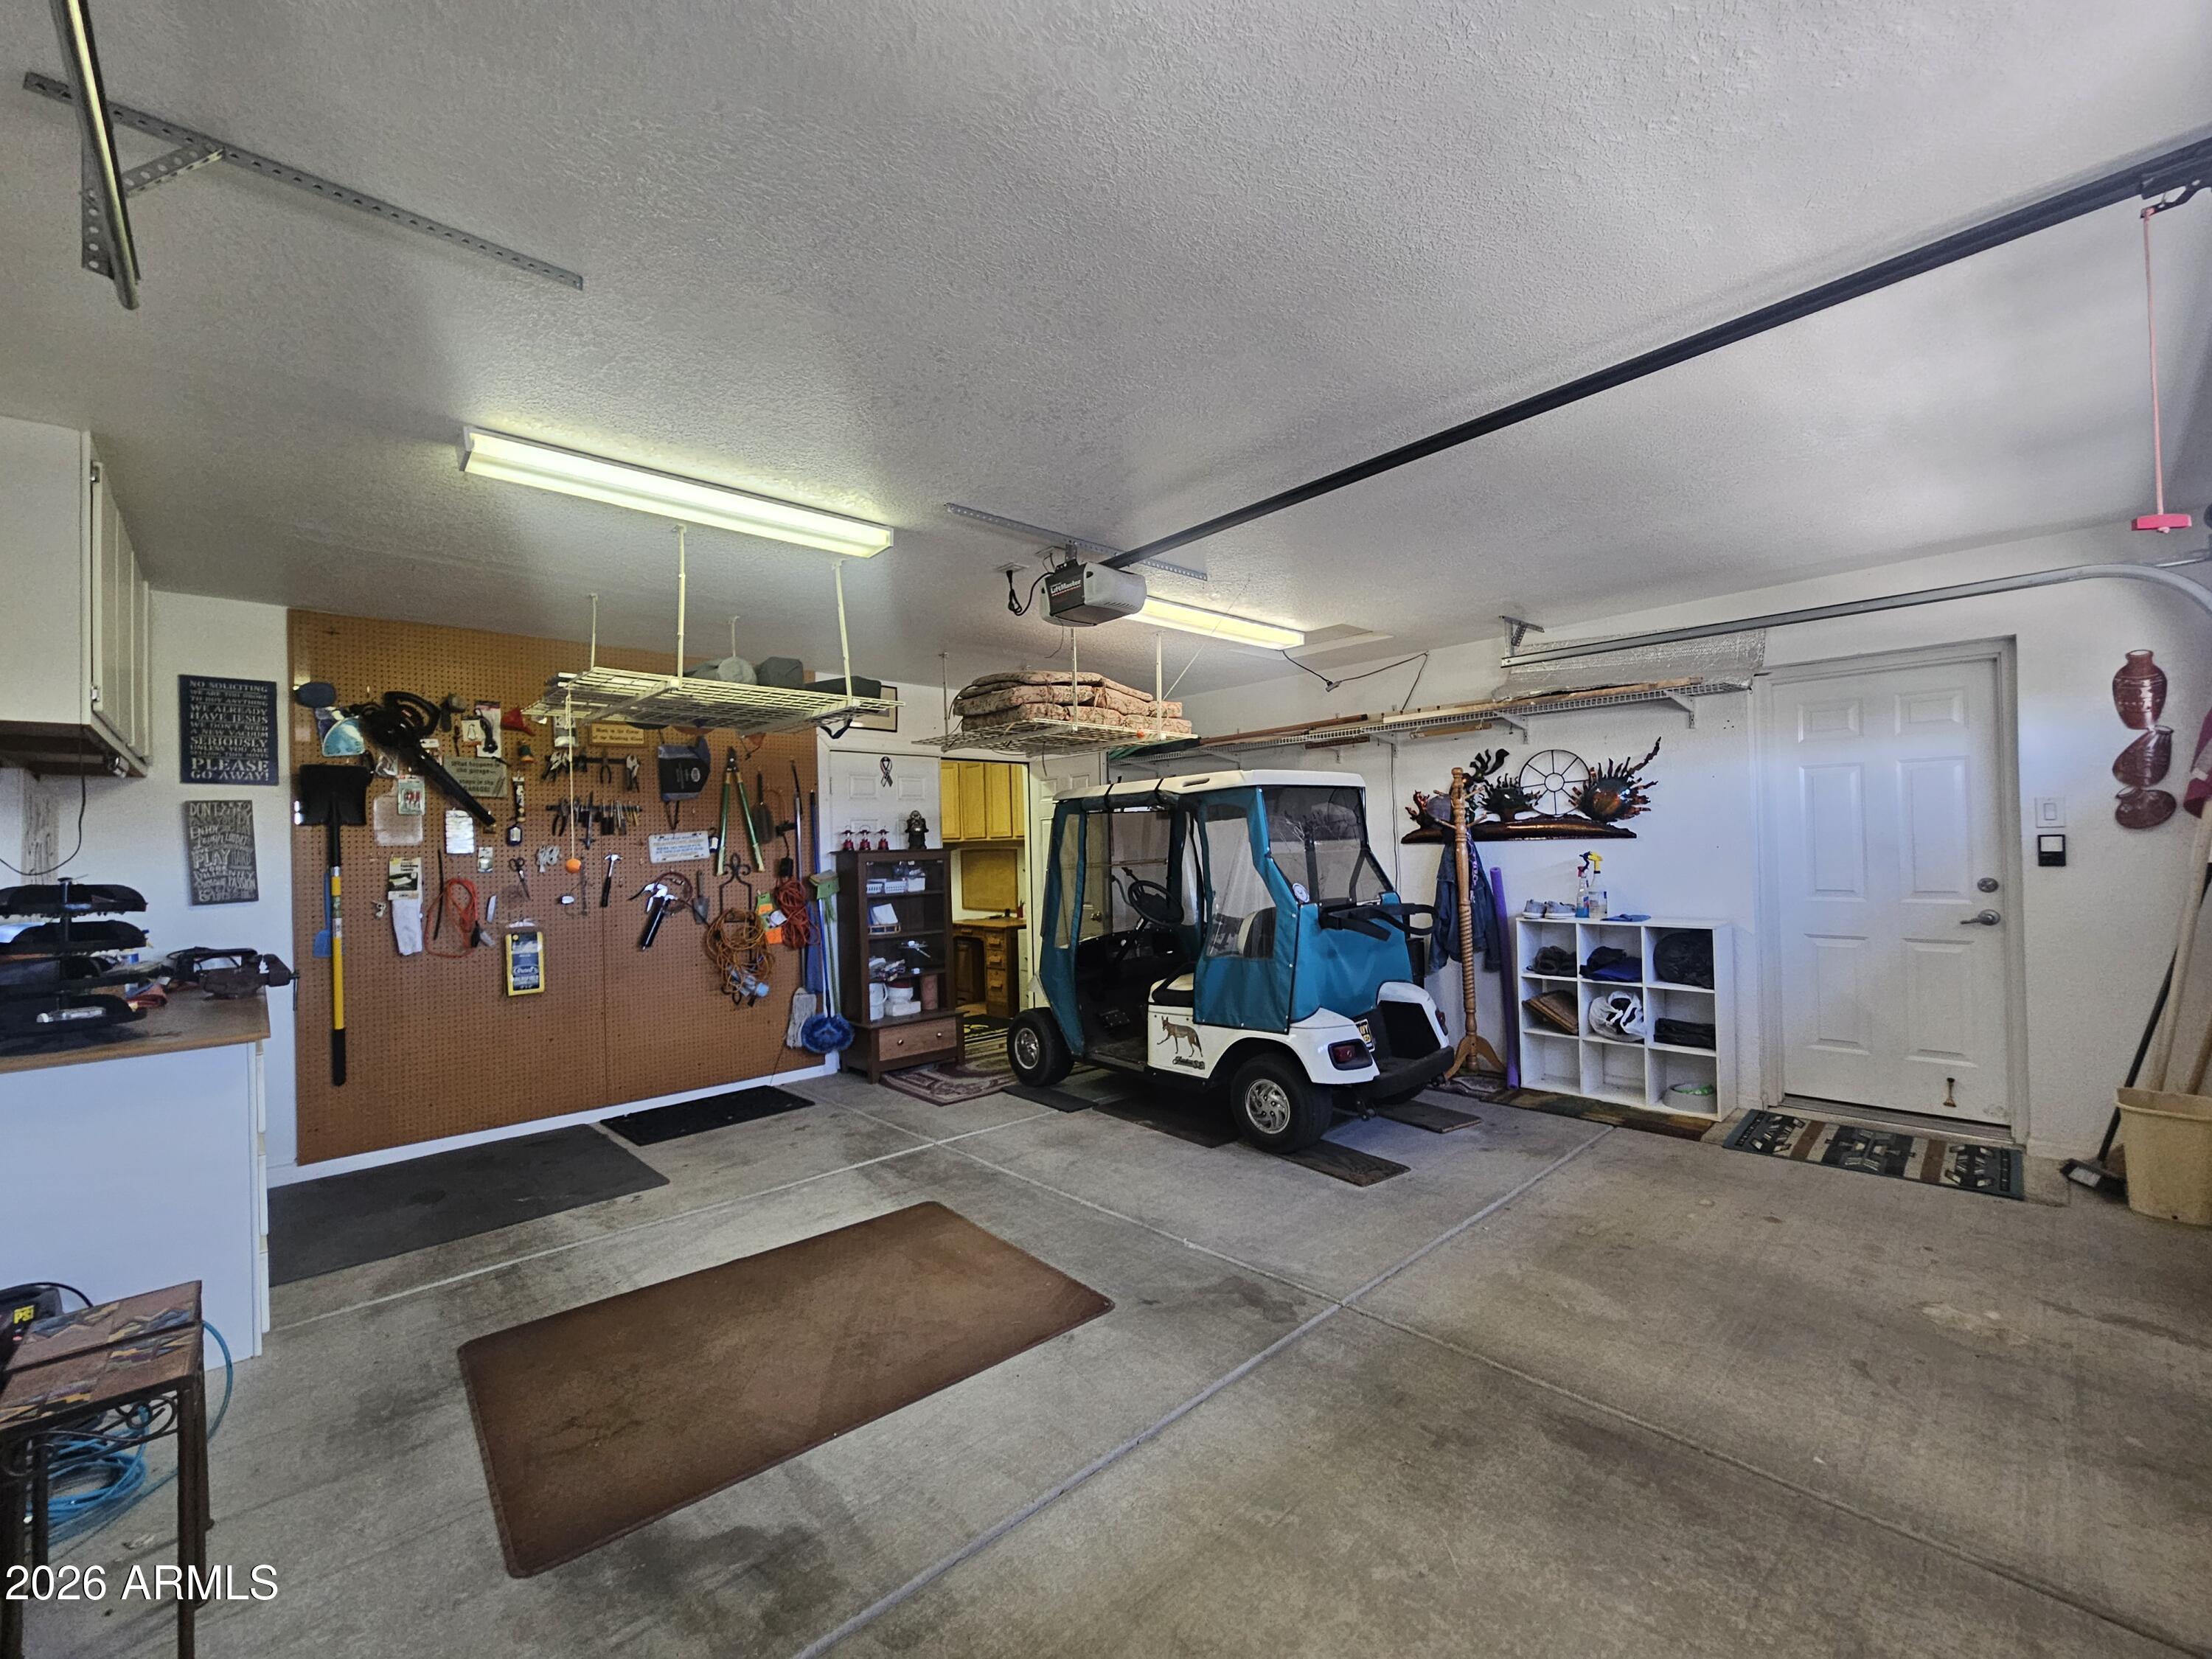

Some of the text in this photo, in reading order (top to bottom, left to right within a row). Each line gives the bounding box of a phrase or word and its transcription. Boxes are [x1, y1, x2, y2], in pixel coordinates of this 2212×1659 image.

[1050, 580, 1081, 594] LiftMaster
[209, 682, 268, 692] SOLICITING
[225, 698, 268, 706] ANYTHING
[214, 706, 266, 715] ALREADY
[190, 712, 268, 723] HAVE JESUS
[190, 737, 267, 748] SERIOUSLY
[192, 757, 269, 772] PLEASE
[191, 770, 268, 782] GO AWAY!
[192, 849, 230, 869] PLAY
